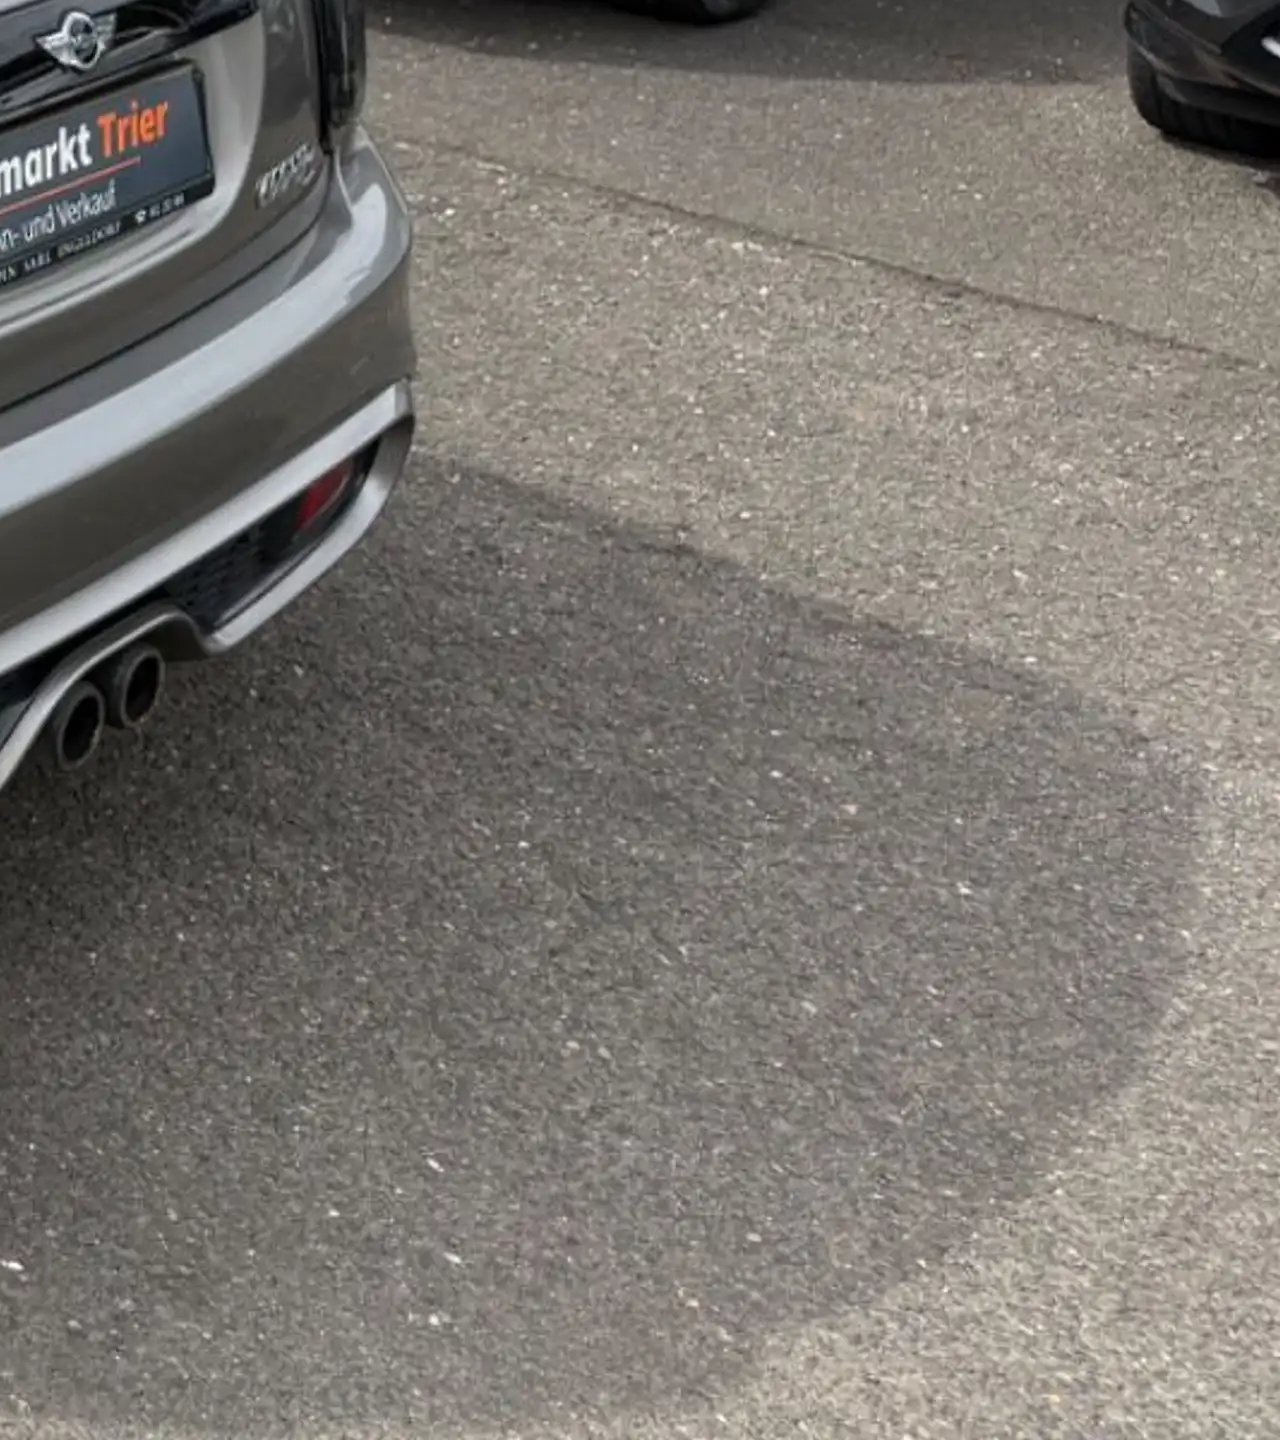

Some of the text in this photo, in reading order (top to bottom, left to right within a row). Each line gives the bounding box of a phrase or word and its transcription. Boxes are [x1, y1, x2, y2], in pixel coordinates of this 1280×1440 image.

[97, 101, 169, 157] Trier
[22, 203, 56, 242] und
[55, 178, 117, 228] Verkauf
